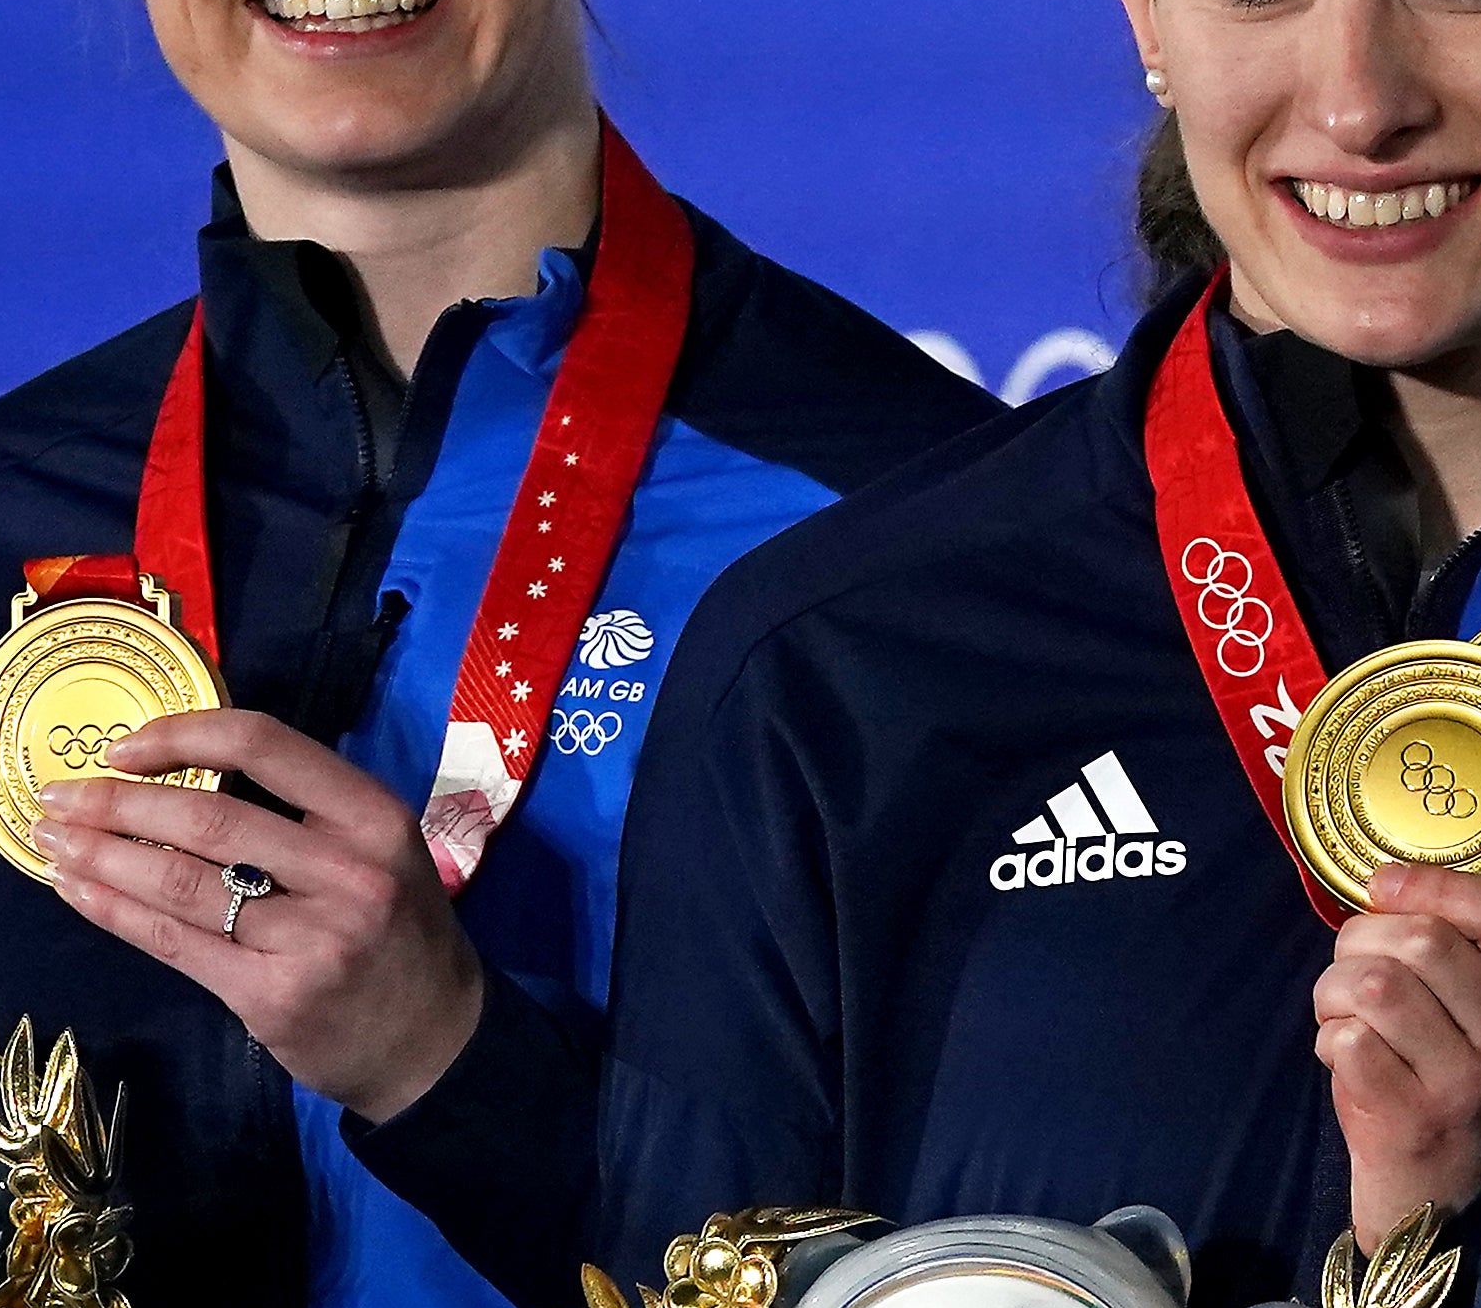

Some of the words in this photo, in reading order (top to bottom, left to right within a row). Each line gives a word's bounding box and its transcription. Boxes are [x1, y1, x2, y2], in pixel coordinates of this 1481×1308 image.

[560, 676, 605, 699] AM
[608, 680, 646, 703] GB
[989, 833, 1187, 891] adidas
